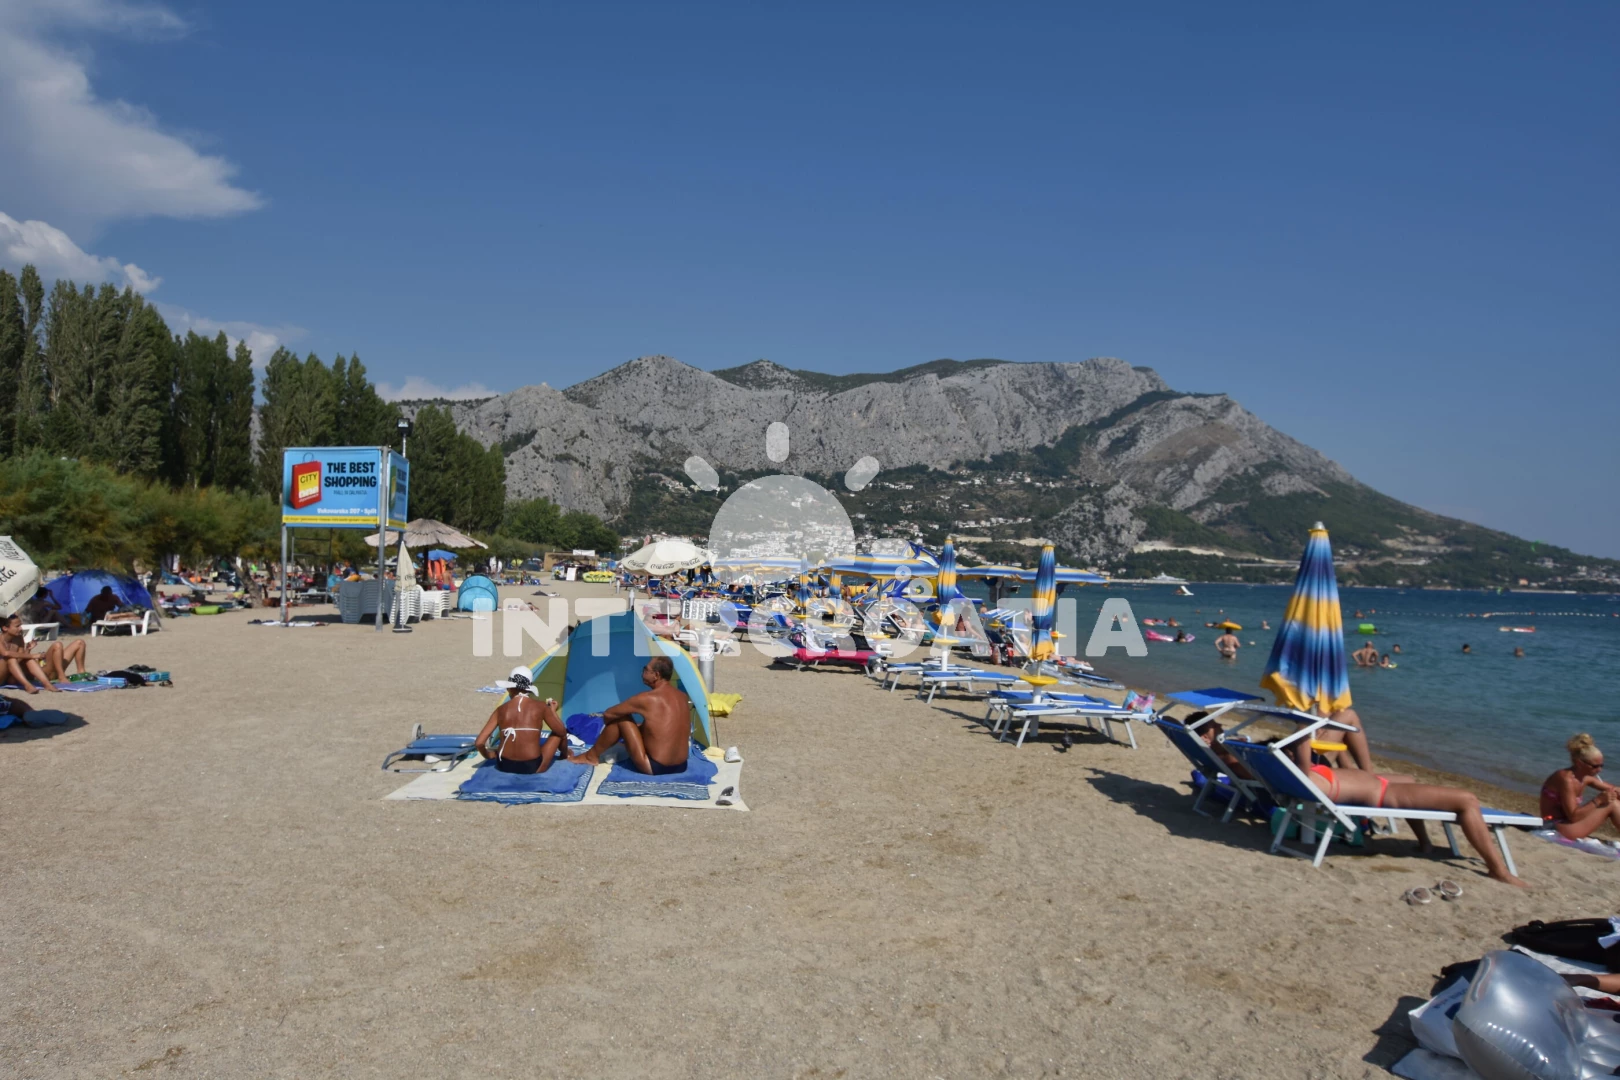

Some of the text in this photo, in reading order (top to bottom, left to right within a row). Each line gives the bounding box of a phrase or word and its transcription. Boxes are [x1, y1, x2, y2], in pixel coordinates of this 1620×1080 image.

[327, 462, 376, 473] THE BEST
[300, 473, 318, 484] CITY
[324, 476, 377, 488] SHOPPING
